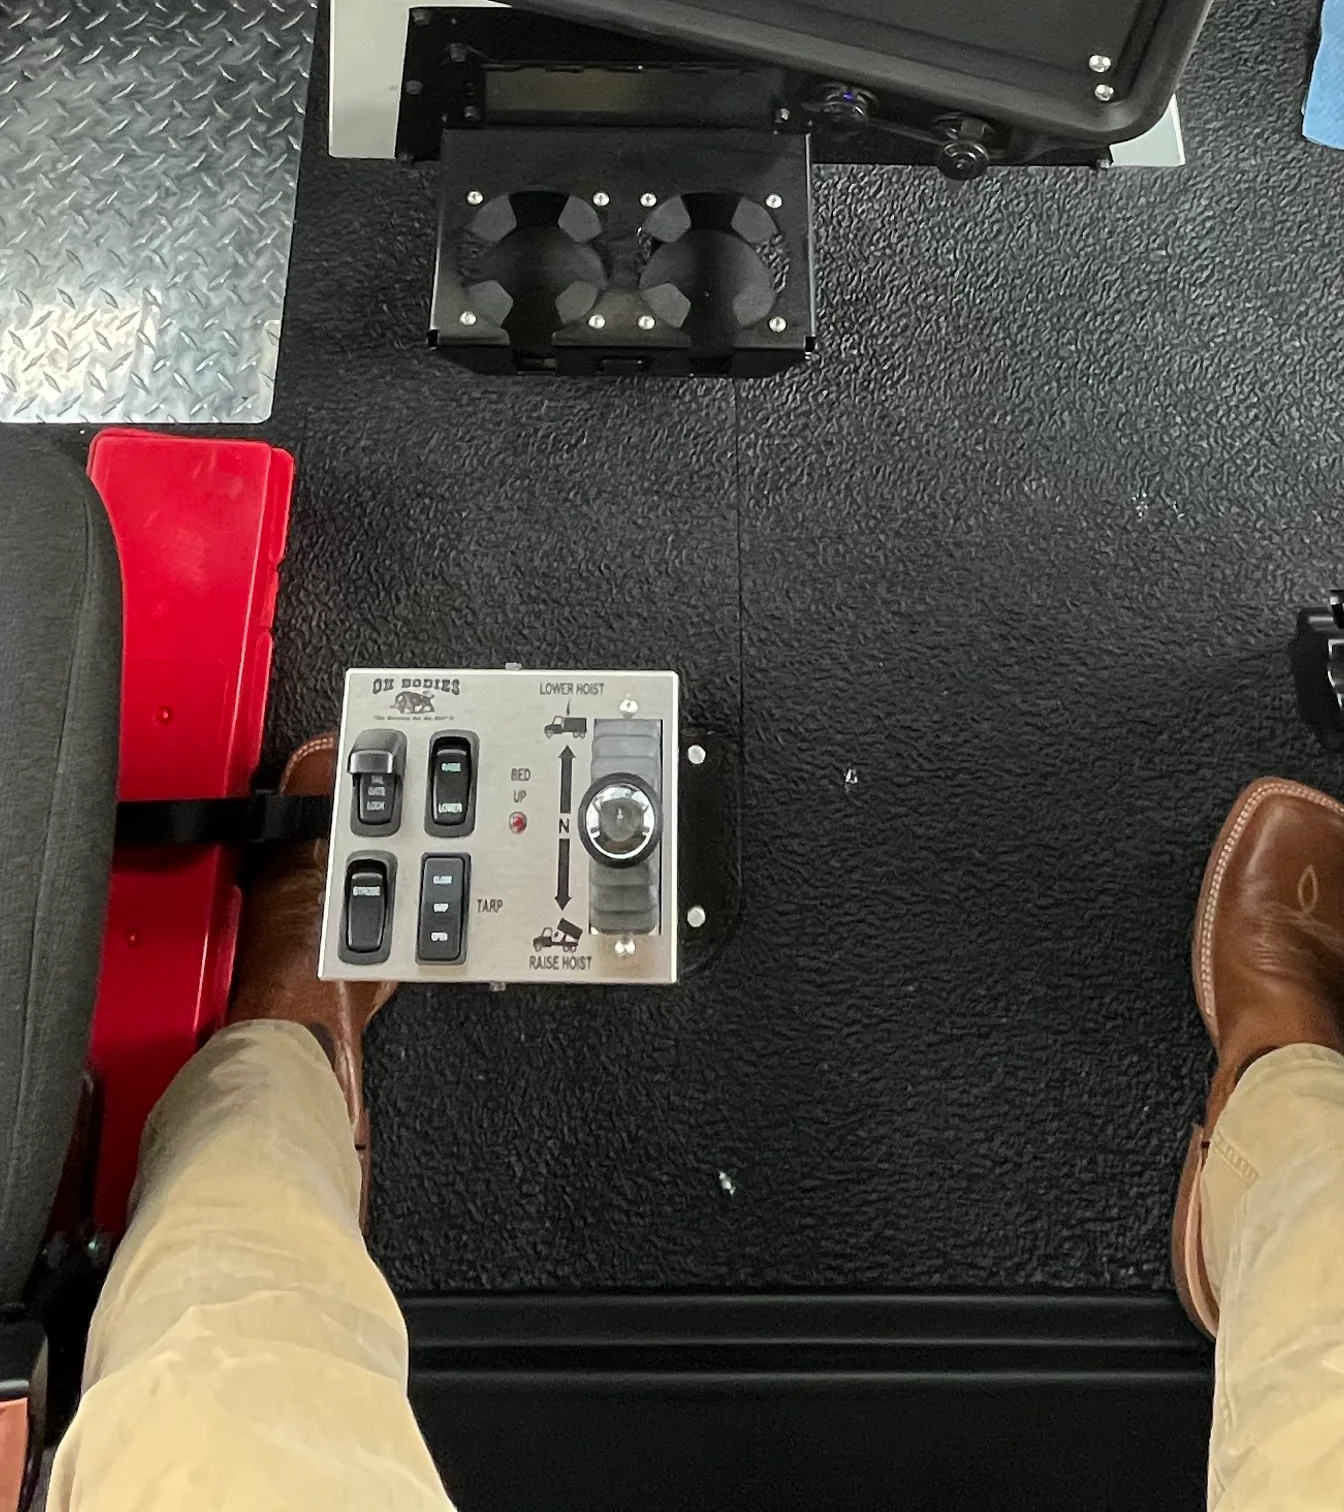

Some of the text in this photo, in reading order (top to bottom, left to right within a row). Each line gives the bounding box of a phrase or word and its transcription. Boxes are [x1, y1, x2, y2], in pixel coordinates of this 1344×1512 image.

[539, 681, 605, 696] LOWER HOIST
[510, 767, 532, 782] BED
[512, 789, 527, 803] UP
[558, 817, 571, 834] N
[476, 898, 504, 914] TARP
[528, 954, 593, 971] RAISE HOIST
